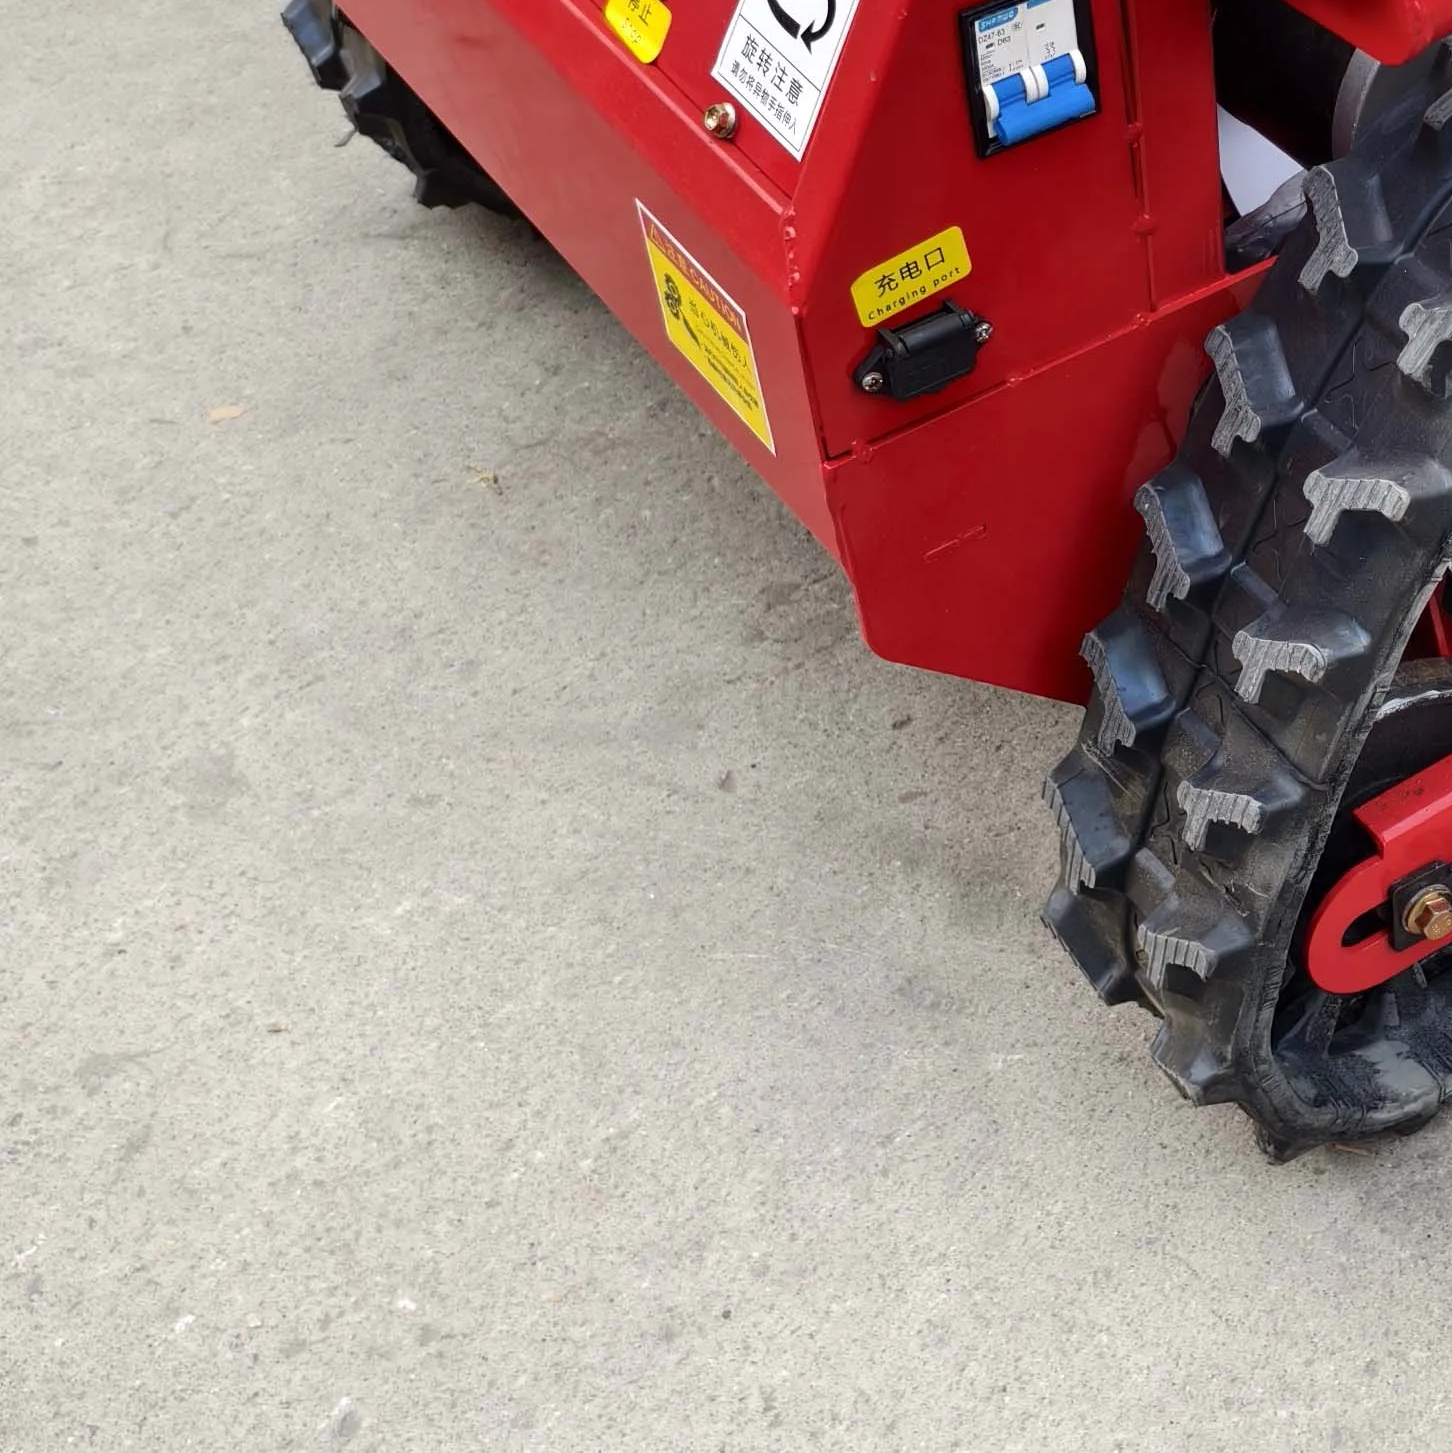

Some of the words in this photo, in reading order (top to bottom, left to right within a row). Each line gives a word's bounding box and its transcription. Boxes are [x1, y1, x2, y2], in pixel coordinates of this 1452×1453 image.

[740, 33, 804, 107] 旋转注意
[867, 285, 927, 321] Charging
[932, 265, 961, 290] port
[874, 246, 946, 299] 充电口
